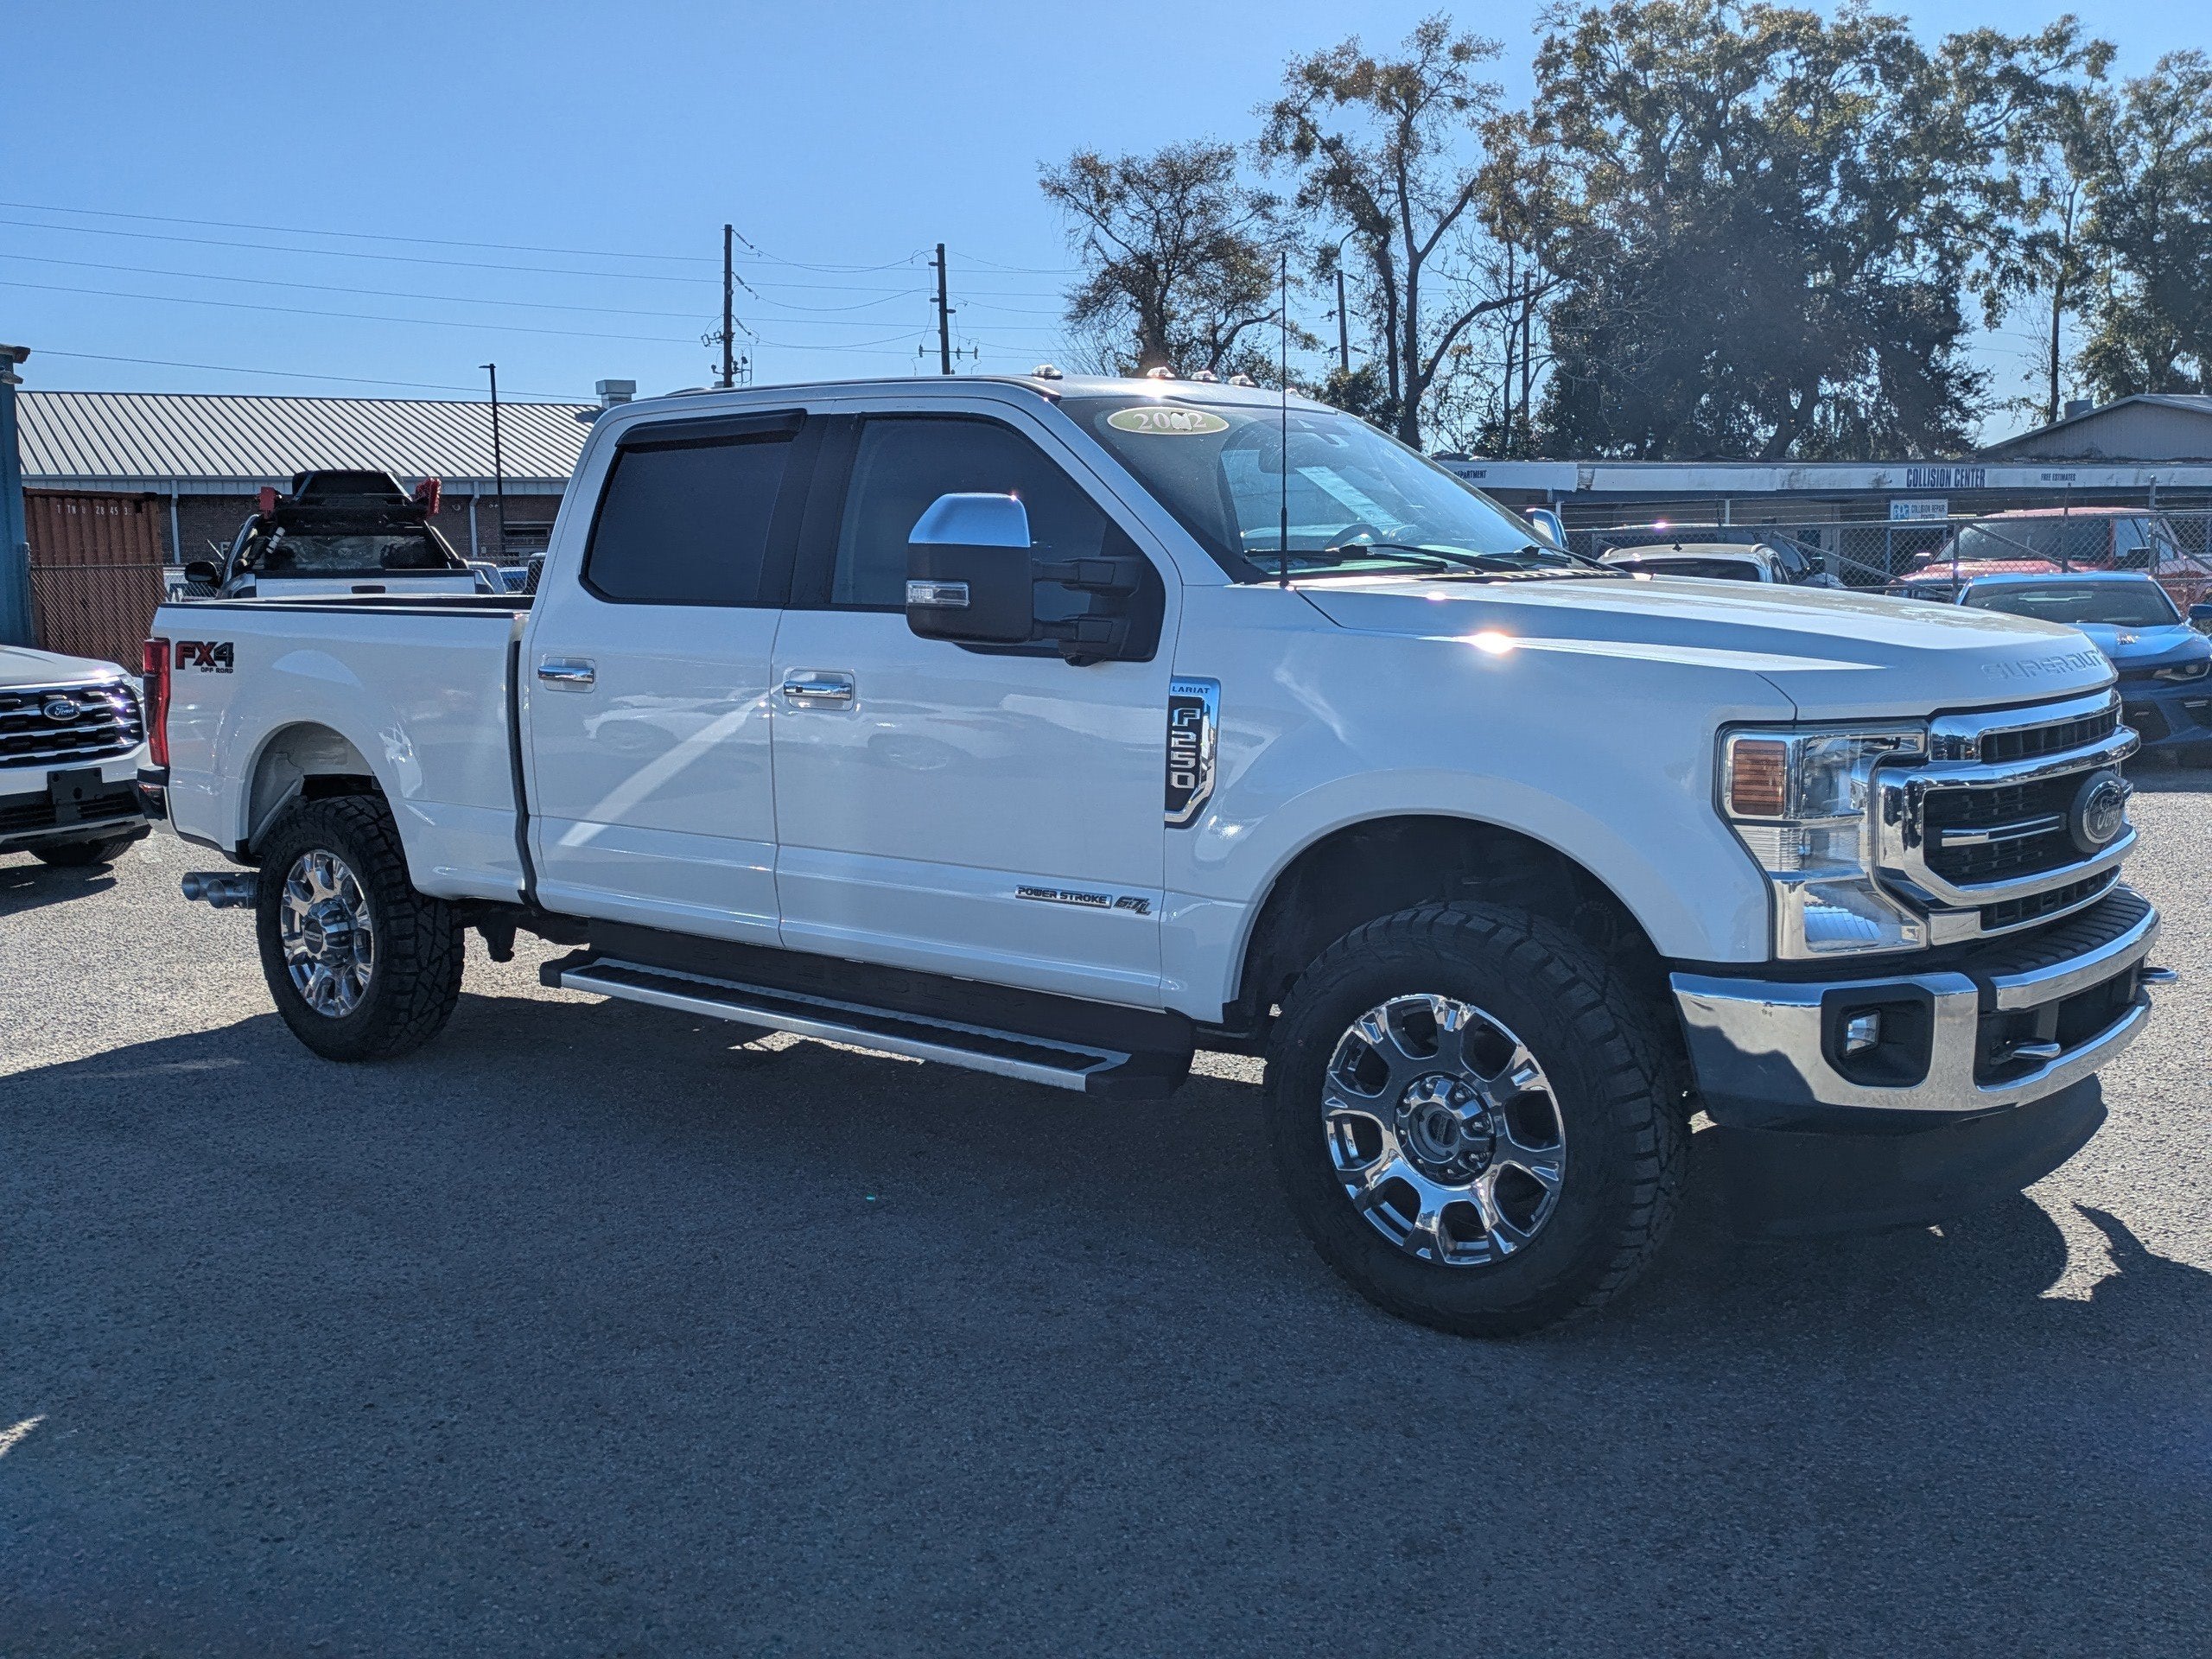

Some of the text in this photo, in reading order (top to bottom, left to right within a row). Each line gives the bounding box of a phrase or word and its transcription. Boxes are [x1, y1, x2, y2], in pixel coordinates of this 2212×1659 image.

[1133, 412, 1207, 430] 202
[1906, 467, 1986, 487] COLLISION CENTER
[175, 641, 234, 670] FX4
[54, 705, 74, 715] Ford
[1170, 708, 1201, 789] F250
[1018, 887, 1057, 899] POWER
[1060, 892, 1107, 904] STROKE
